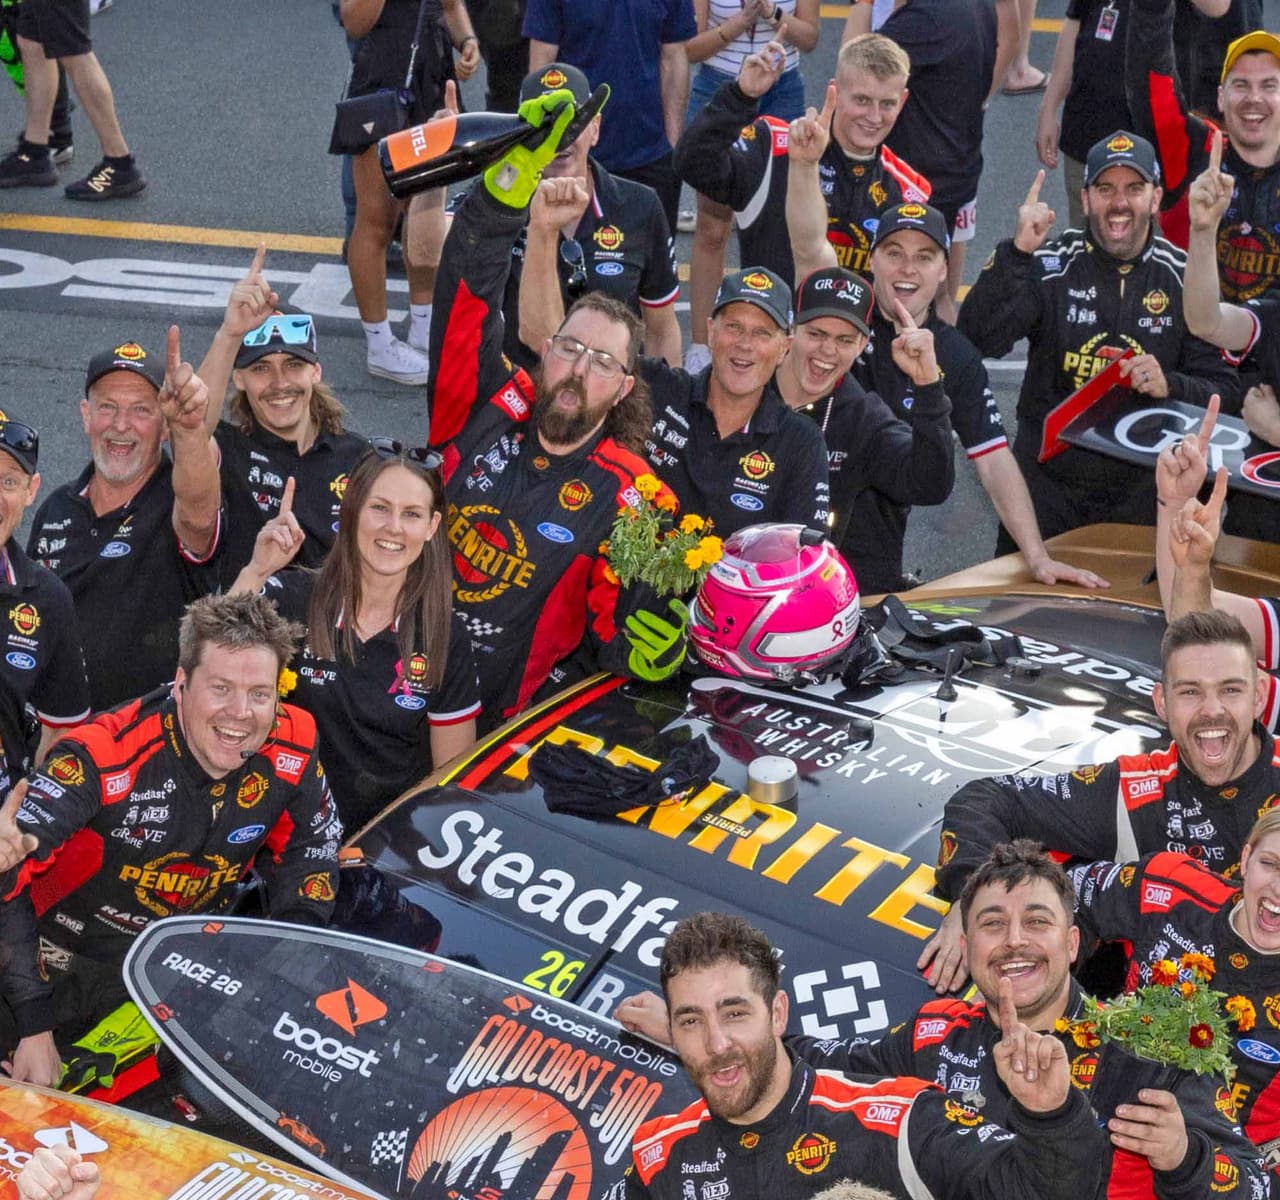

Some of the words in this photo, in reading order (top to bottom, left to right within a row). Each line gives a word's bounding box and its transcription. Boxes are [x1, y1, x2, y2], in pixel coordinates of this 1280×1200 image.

[815, 277, 864, 298] GROVE
[1138, 316, 1173, 329] GROVE
[738, 456, 776, 472] PENRITE
[734, 495, 761, 508] Ford
[540, 523, 571, 540] Ford
[8, 609, 41, 627] PENRITE
[9, 654, 33, 667] Ford
[300, 665, 337, 681] GROVE
[742, 702, 951, 786] AUSTRALIAN
[275, 755, 303, 774] OMP
[757, 727, 890, 784] WHISKY
[30, 775, 64, 800] OMP
[105, 775, 132, 794] OMP
[1128, 780, 1160, 797] OMP
[140, 808, 170, 825] NED
[703, 811, 752, 839] PENRITE
[230, 827, 262, 841] Ford
[503, 725, 952, 941] PNRITE
[1166, 840, 1224, 861] GROVE
[118, 863, 242, 898] PENRITE
[417, 808, 677, 968] Steadfa
[1144, 888, 1173, 906] OMP
[161, 951, 211, 984] RACE
[209, 973, 244, 997] 26
[523, 949, 586, 999] 26
[916, 1022, 946, 1039] OMP
[272, 1010, 380, 1079] boost
[1241, 1041, 1279, 1061] Ford
[282, 1047, 344, 1084] mobile
[588, 1069, 665, 1167] 500
[866, 1105, 901, 1122] OMP
[640, 1145, 664, 1165] OMP
[785, 1141, 837, 1164] PENRITE
